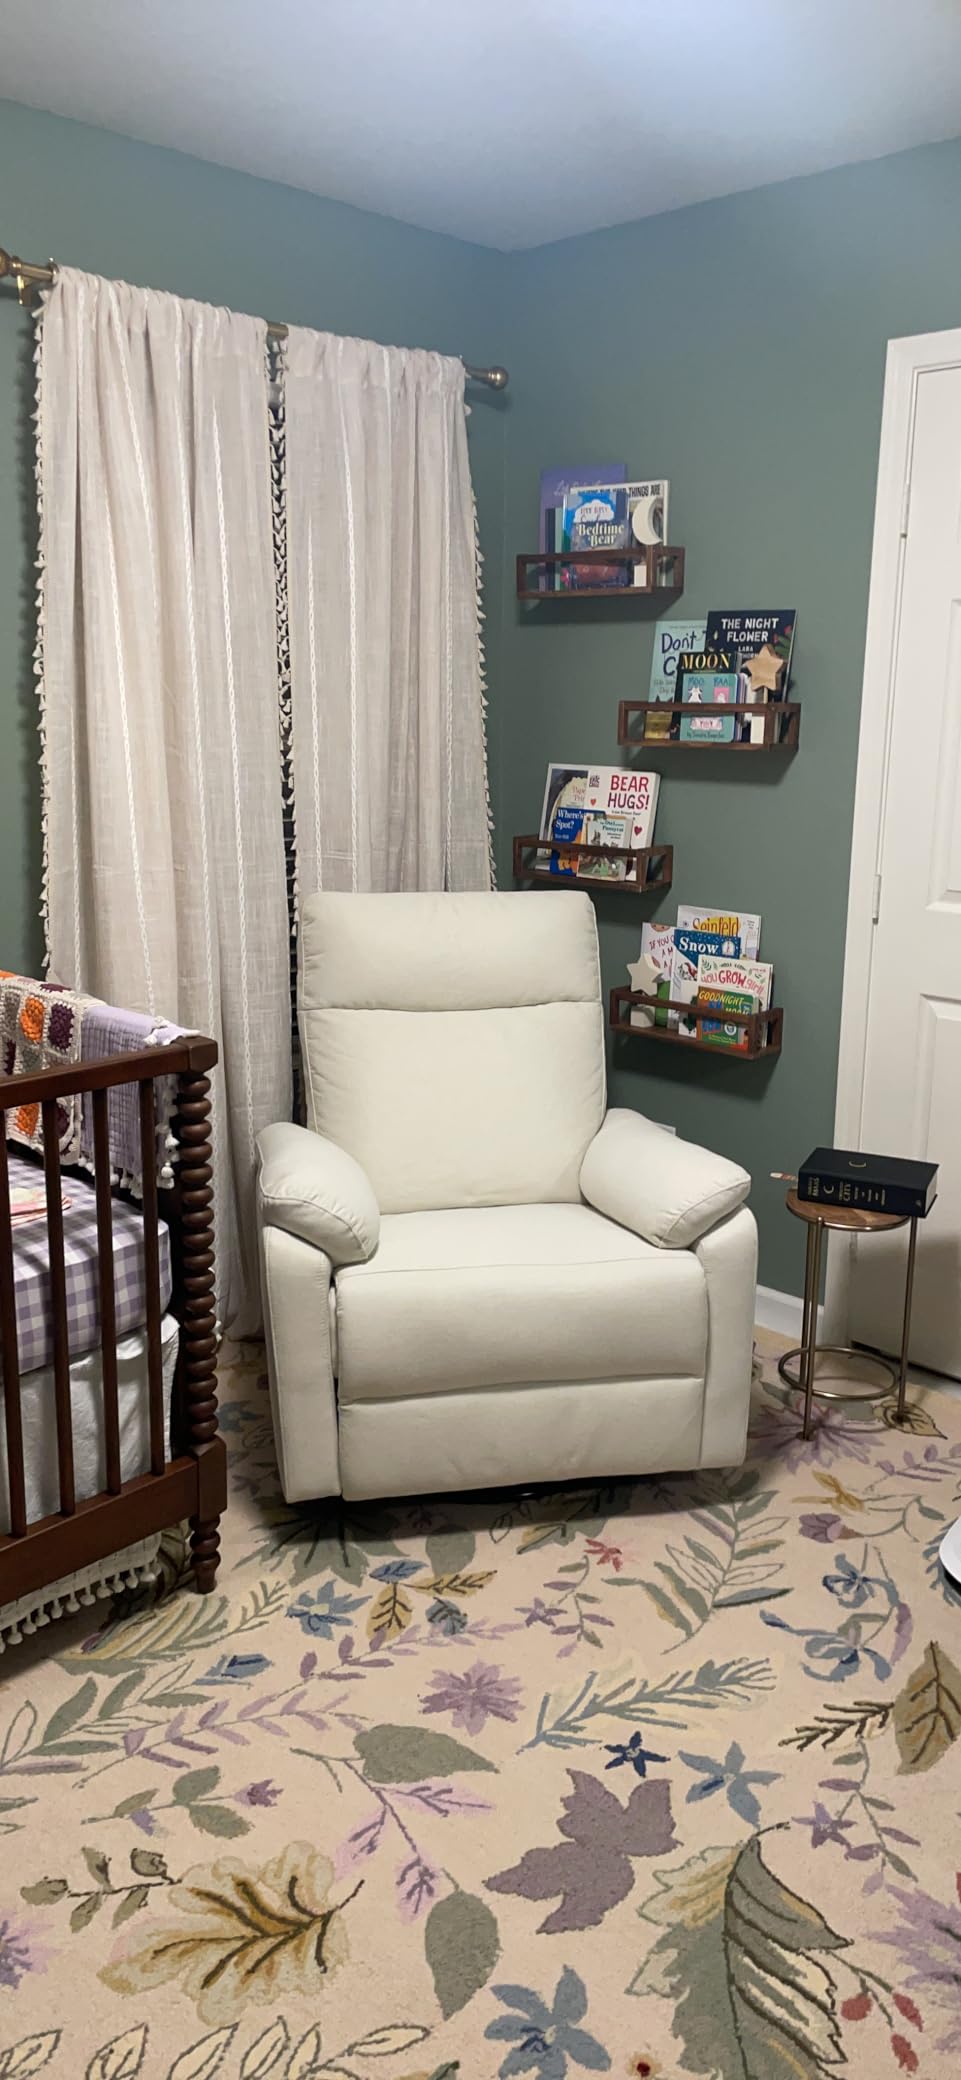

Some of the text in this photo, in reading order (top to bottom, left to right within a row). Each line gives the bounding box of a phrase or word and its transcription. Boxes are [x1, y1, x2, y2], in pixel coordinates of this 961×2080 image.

[628, 485, 649, 498] THINGS
[650, 484, 661, 496] ARE
[576, 521, 625, 536] Bedtime
[587, 535, 616, 547] Bear
[721, 617, 779, 630] THE NIGHT
[726, 631, 769, 643] FLOWER
[681, 653, 732, 670] MOON
[610, 774, 649, 793] BEAR
[607, 792, 650, 810] HUGS!
[557, 809, 584, 821] Where's
[555, 820, 575, 830] Spot?
[692, 916, 739, 937] Seinfeld
[656, 936, 669, 947] YOU
[679, 936, 719, 955] Snow
[698, 990, 744, 1006] GOODNIGHT
